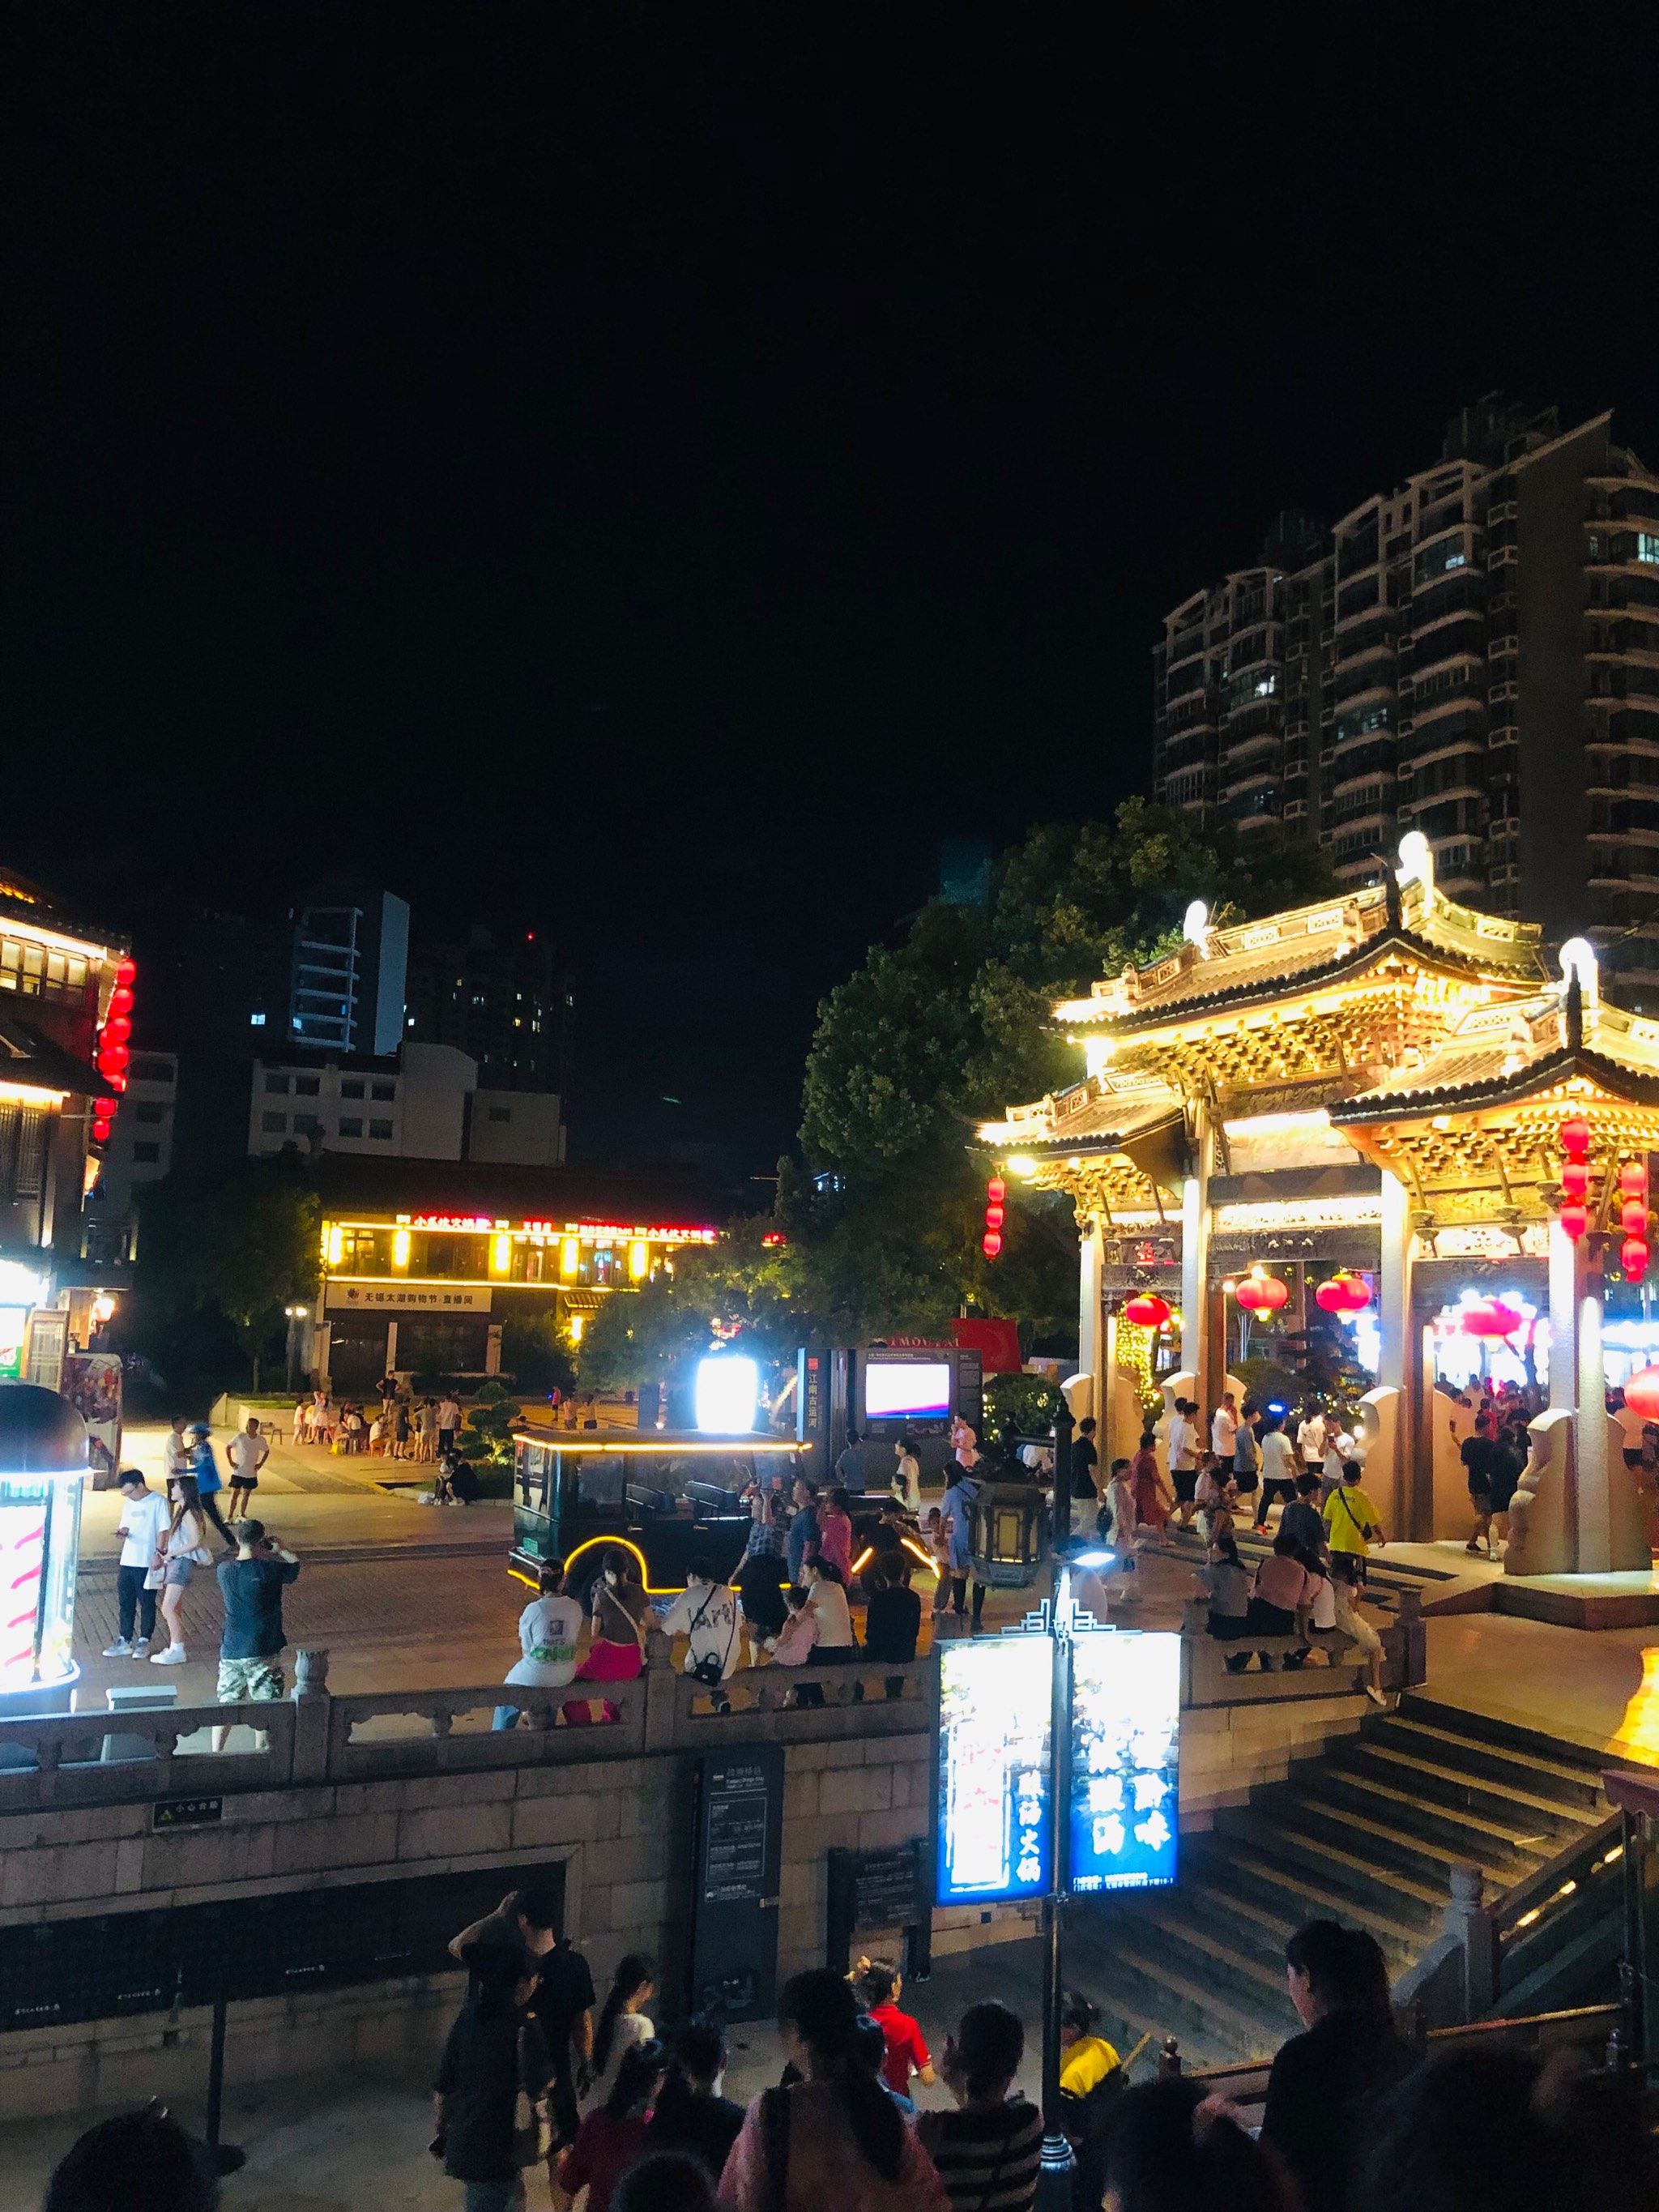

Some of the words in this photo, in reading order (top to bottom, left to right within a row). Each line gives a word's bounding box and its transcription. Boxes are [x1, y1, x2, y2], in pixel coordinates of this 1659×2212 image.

[808, 1374, 817, 1428] 江南古运河
